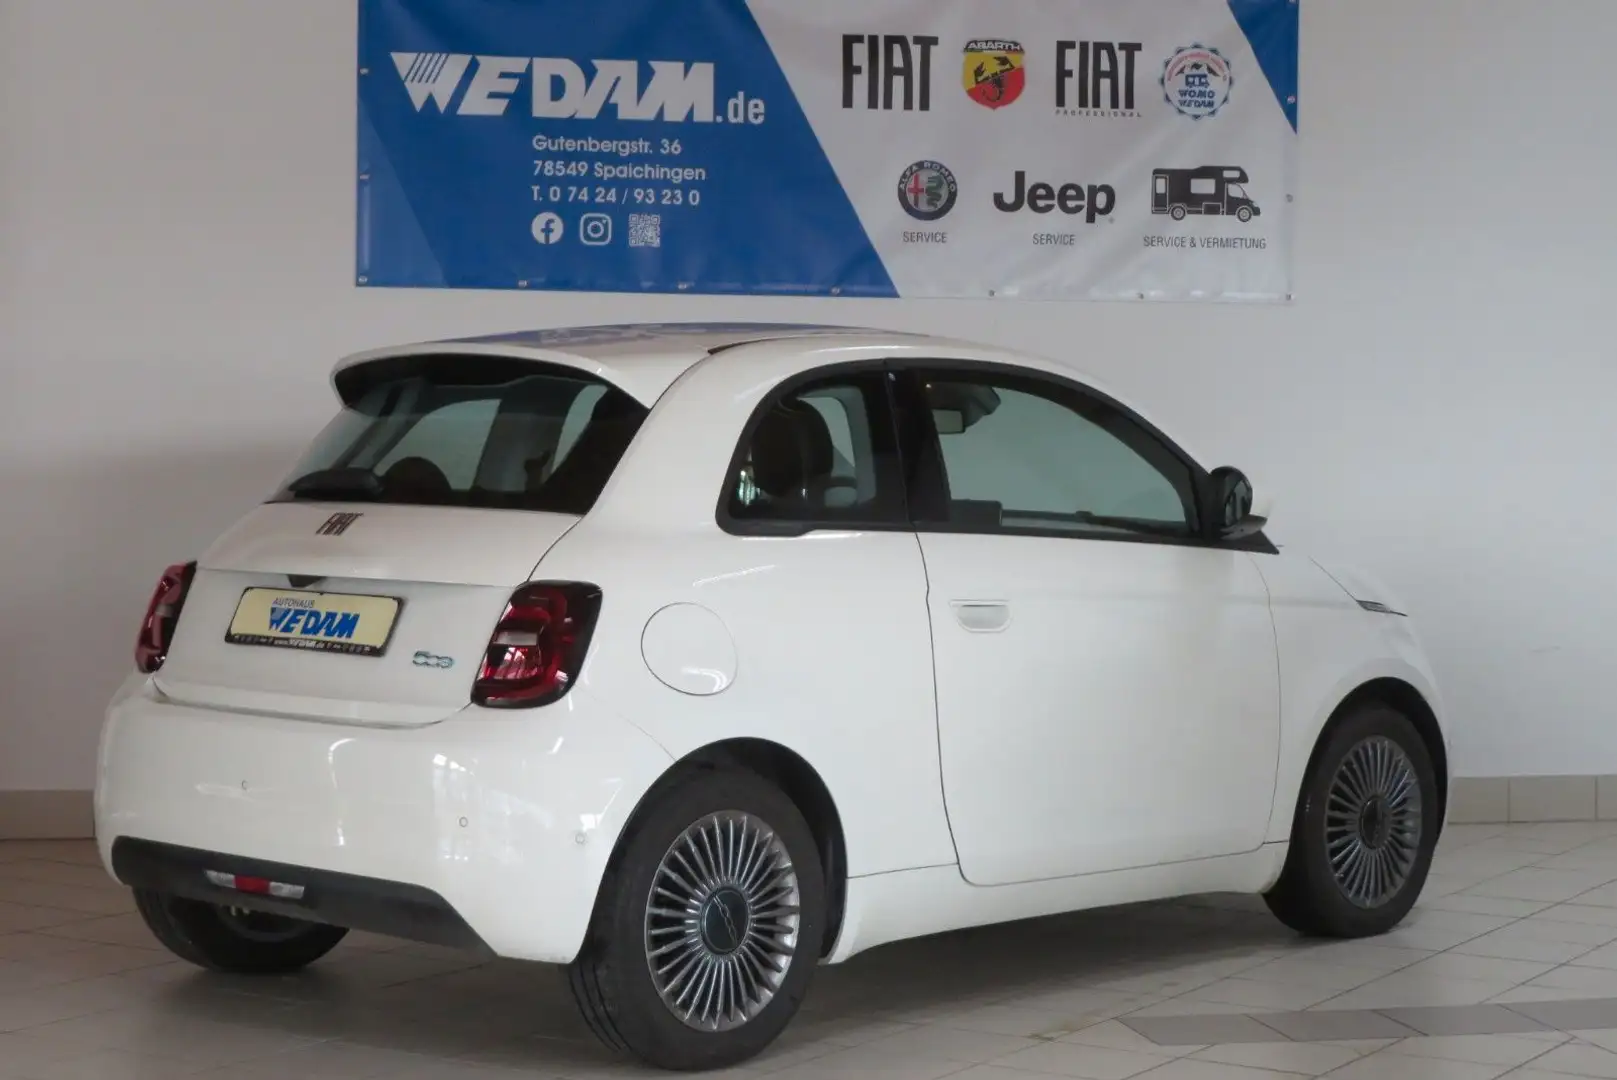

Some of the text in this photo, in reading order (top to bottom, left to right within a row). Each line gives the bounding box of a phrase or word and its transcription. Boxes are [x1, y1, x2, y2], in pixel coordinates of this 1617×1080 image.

[966, 40, 1022, 51] ABARTH
[842, 34, 938, 111] FIAT
[1056, 40, 1142, 110] FIAT
[532, 134, 682, 156] Gutenbergstr. 36
[533, 160, 706, 183] 78549 Spaichingen
[923, 161, 956, 192] ROMEO
[531, 186, 543, 201] T.
[549, 186, 561, 202] 0
[567, 187, 589, 203] 74
[595, 188, 617, 203] 24
[634, 188, 655, 204] 93
[661, 190, 682, 205] 23
[688, 190, 700, 206] 0
[993, 170, 1116, 223] Jeep
[903, 231, 948, 243] SERVICE
[1032, 233, 1075, 245] SERVICE
[1143, 235, 1267, 249] SERVICE & VERMIETUNG
[315, 512, 364, 536] FIAT
[269, 607, 360, 638] WEDAM
